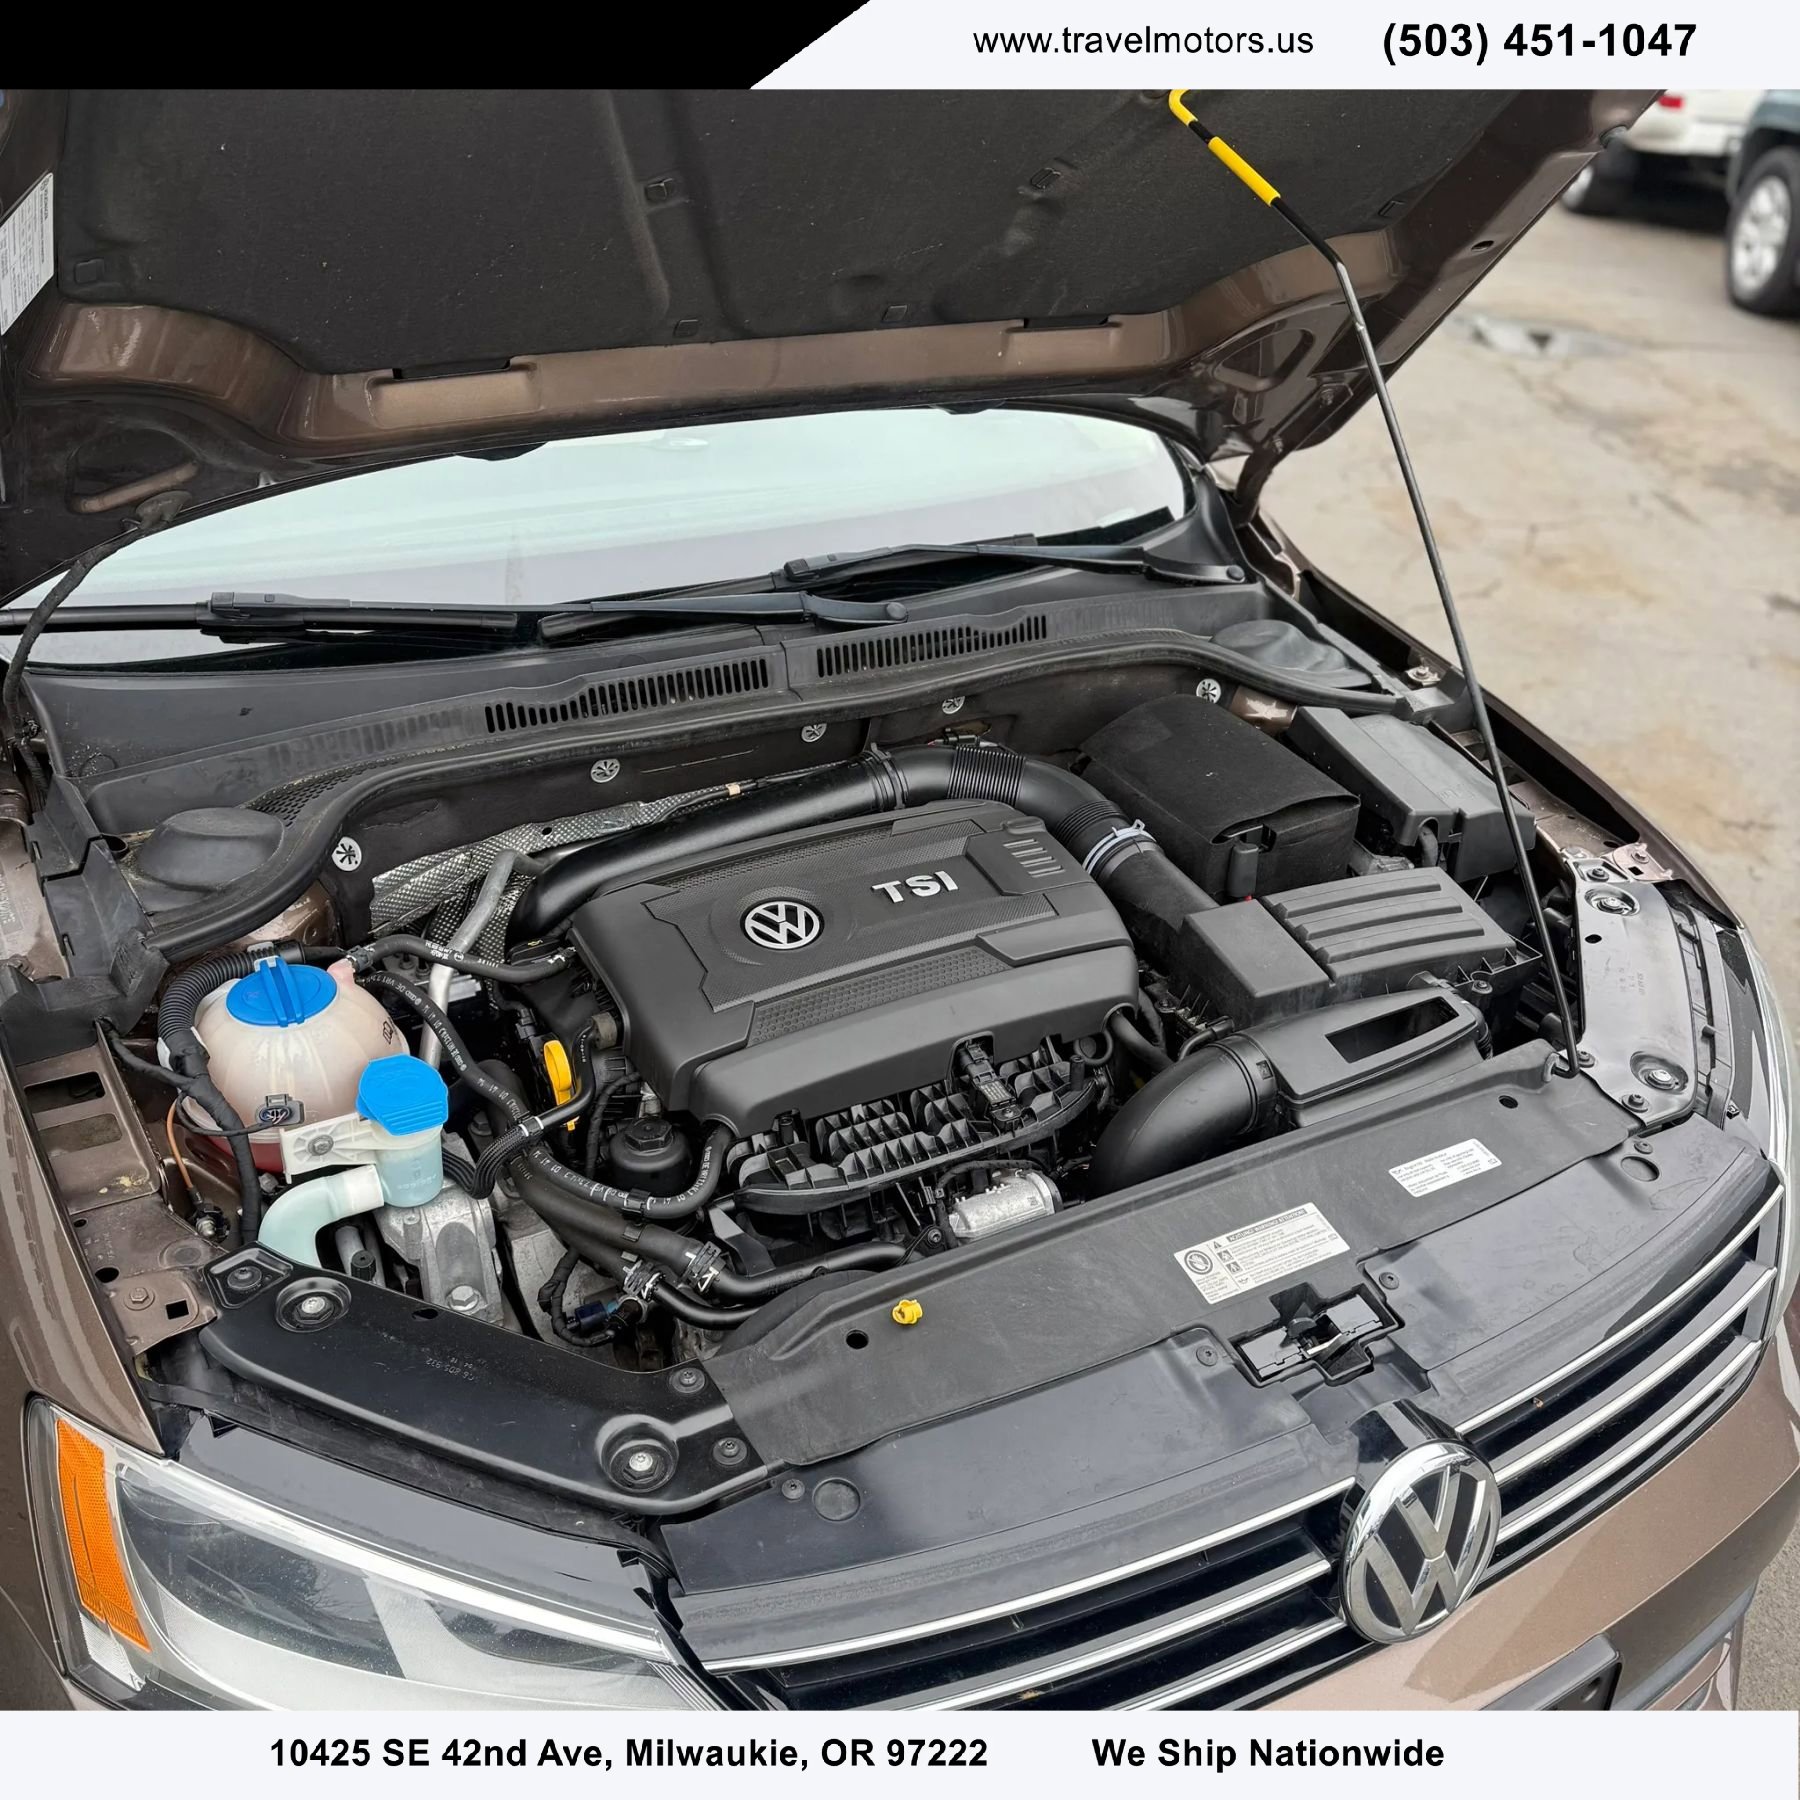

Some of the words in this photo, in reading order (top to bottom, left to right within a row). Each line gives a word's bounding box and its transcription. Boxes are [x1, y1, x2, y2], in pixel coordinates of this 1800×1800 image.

[871, 870, 959, 903] TSI
[745, 901, 820, 950] VW
[1344, 1441, 1500, 1642] VW
